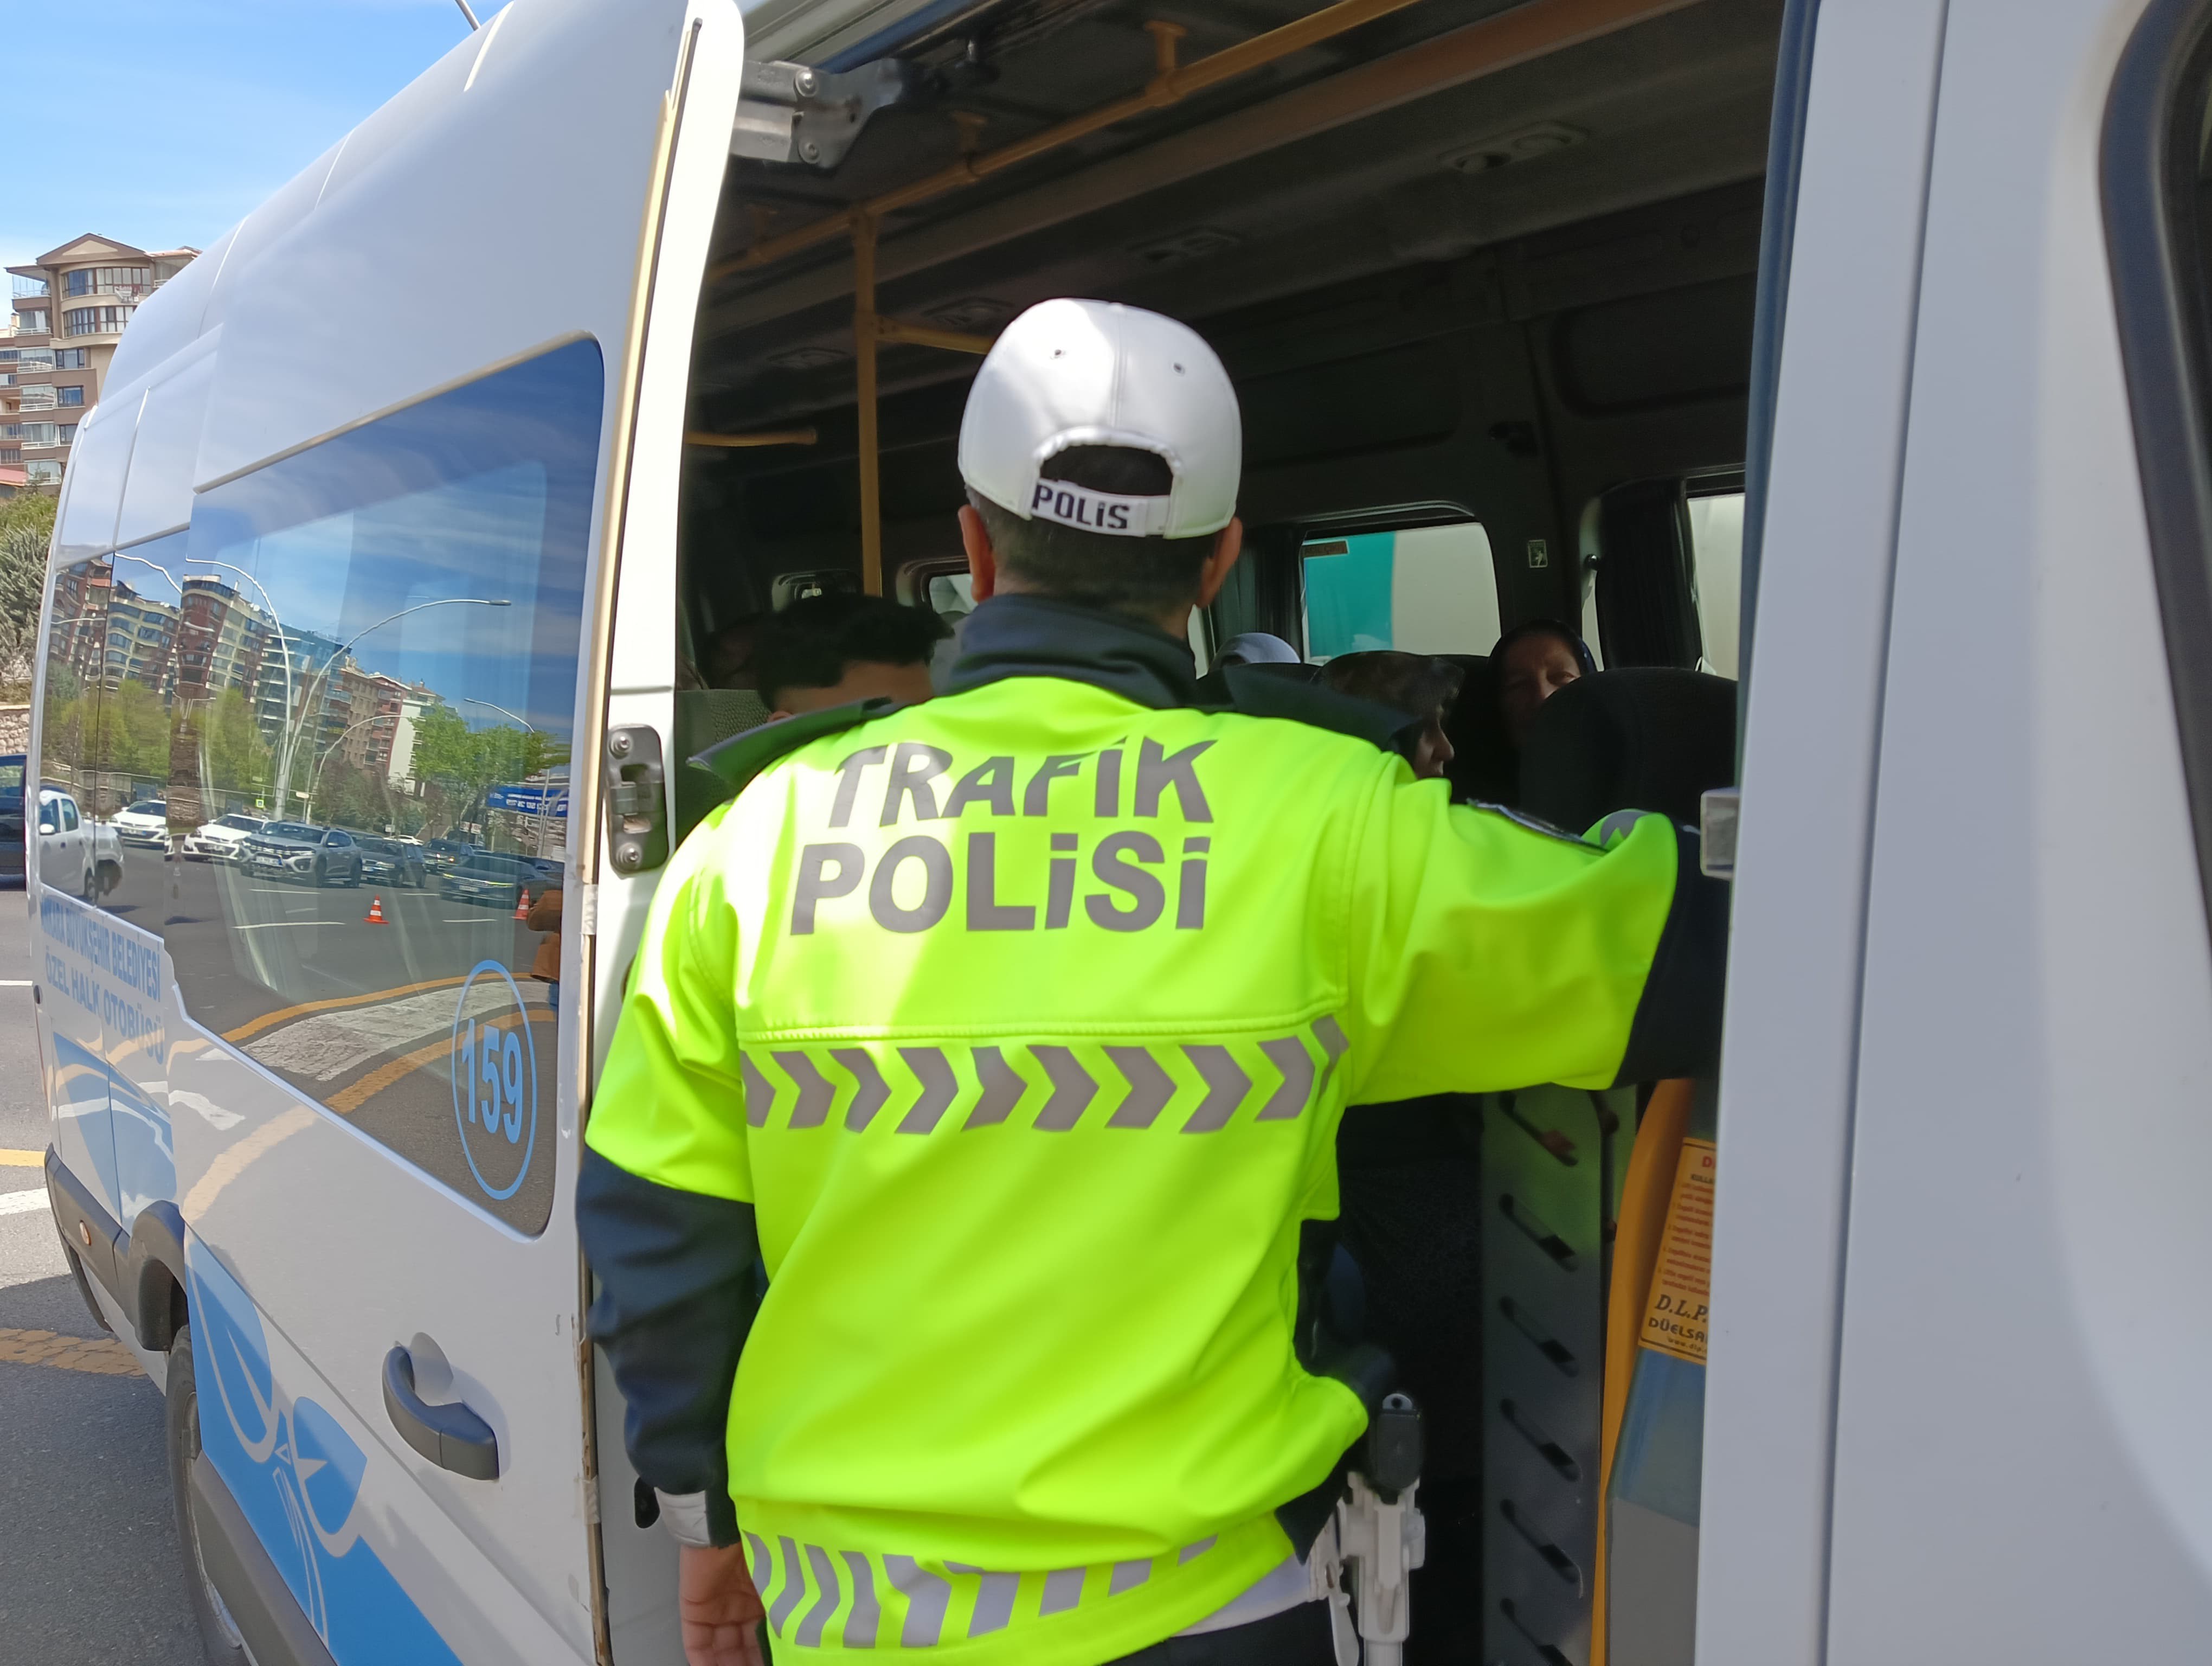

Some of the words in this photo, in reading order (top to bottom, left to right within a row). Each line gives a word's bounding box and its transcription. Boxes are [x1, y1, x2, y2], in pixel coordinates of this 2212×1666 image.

[46, 945, 70, 997] ÖZEL
[72, 967, 100, 1015] HALK
[104, 988, 163, 1065] OTOBÜSÜ
[112, 931, 160, 1003] BELEDİYESİ
[462, 1018, 522, 1143] 159
[1655, 1294, 1708, 1323] D.L.P.
